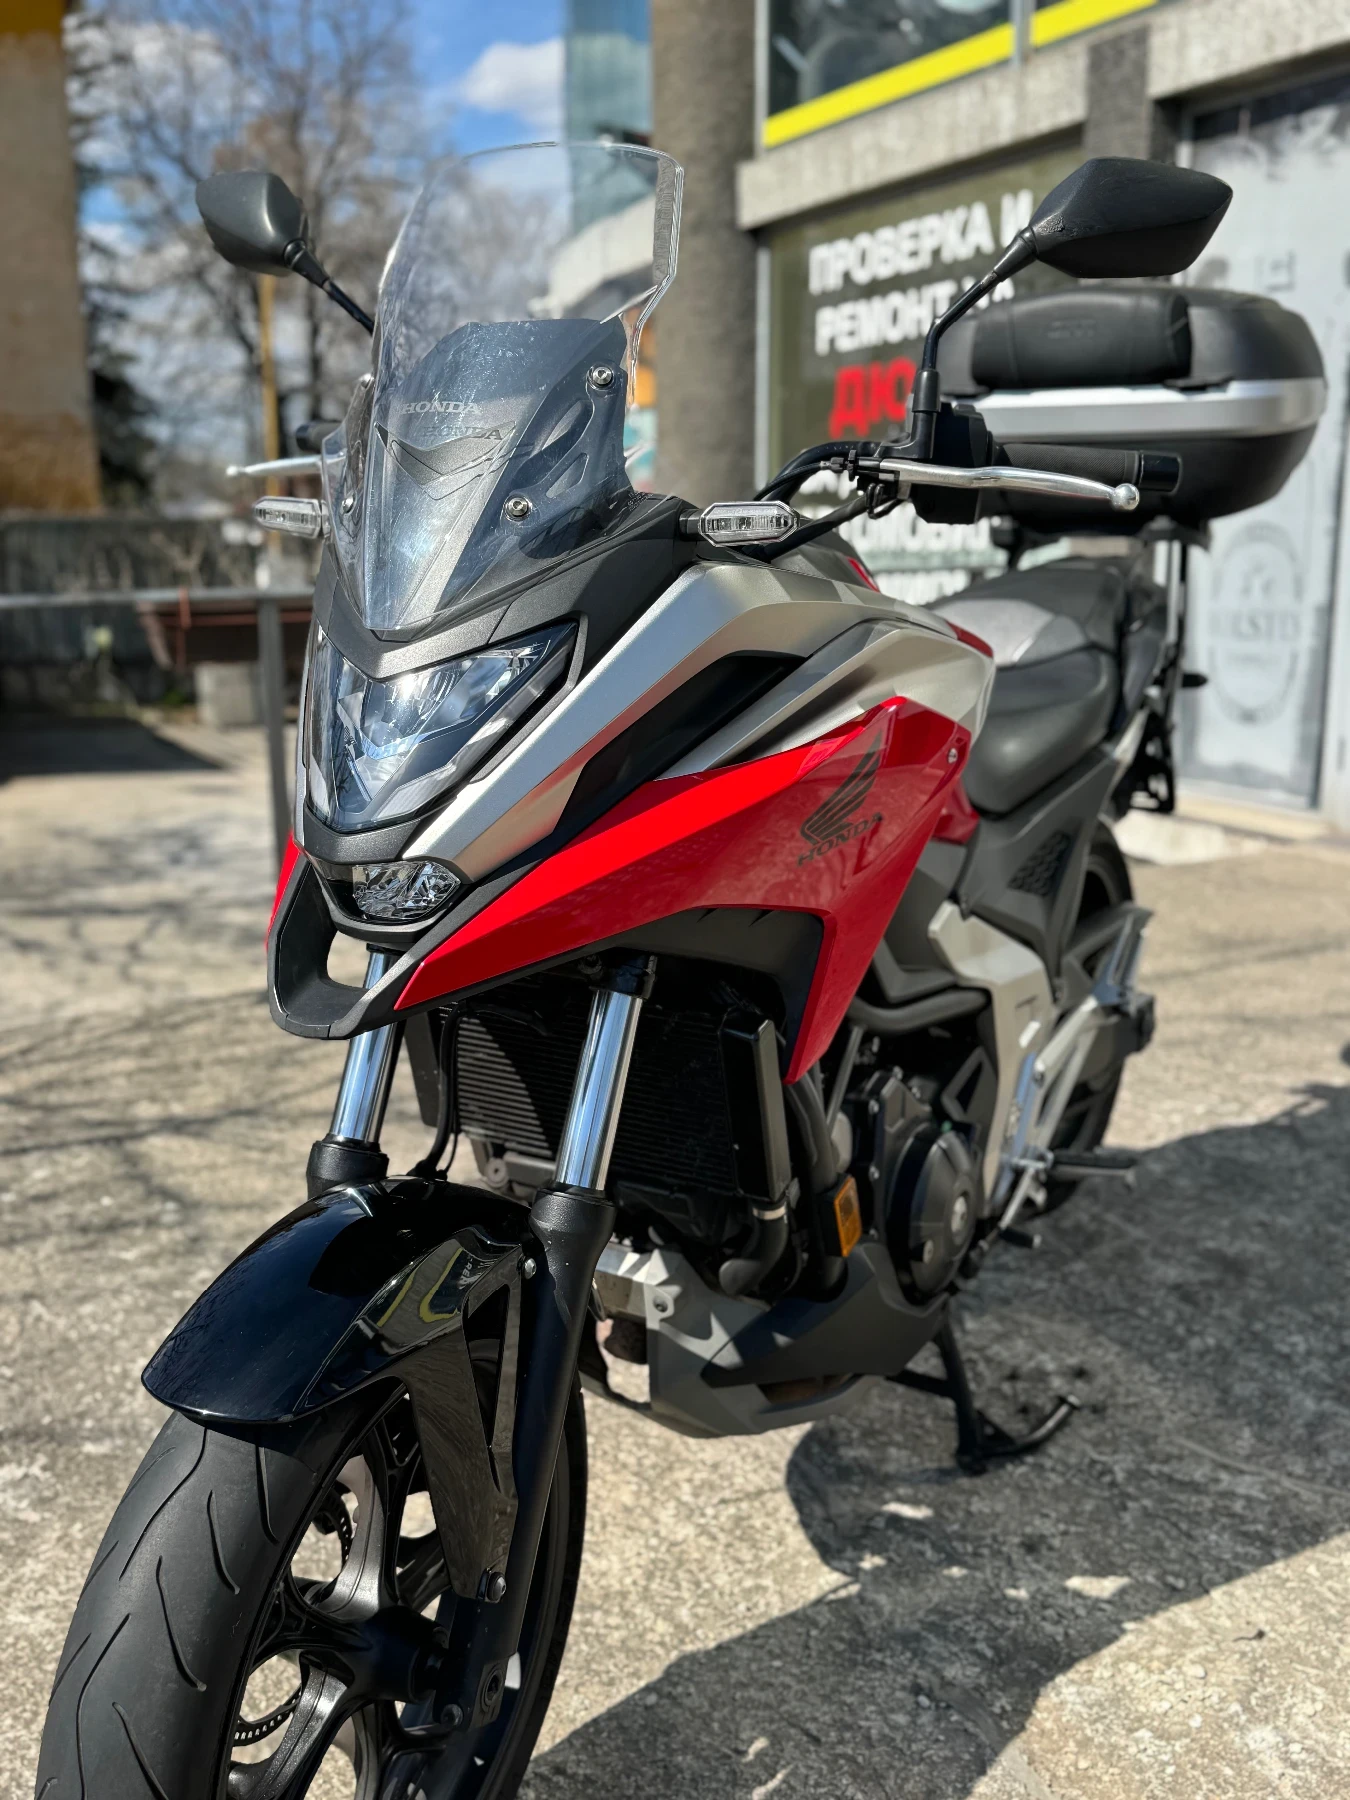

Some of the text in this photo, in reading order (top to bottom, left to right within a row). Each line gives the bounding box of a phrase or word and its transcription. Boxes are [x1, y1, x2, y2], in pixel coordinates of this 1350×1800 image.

[808, 201, 995, 295] ПРОВЕРКА
[814, 278, 958, 357] РЕМОНТ
[401, 401, 481, 415] HONDA
[797, 812, 883, 867] HONDA
